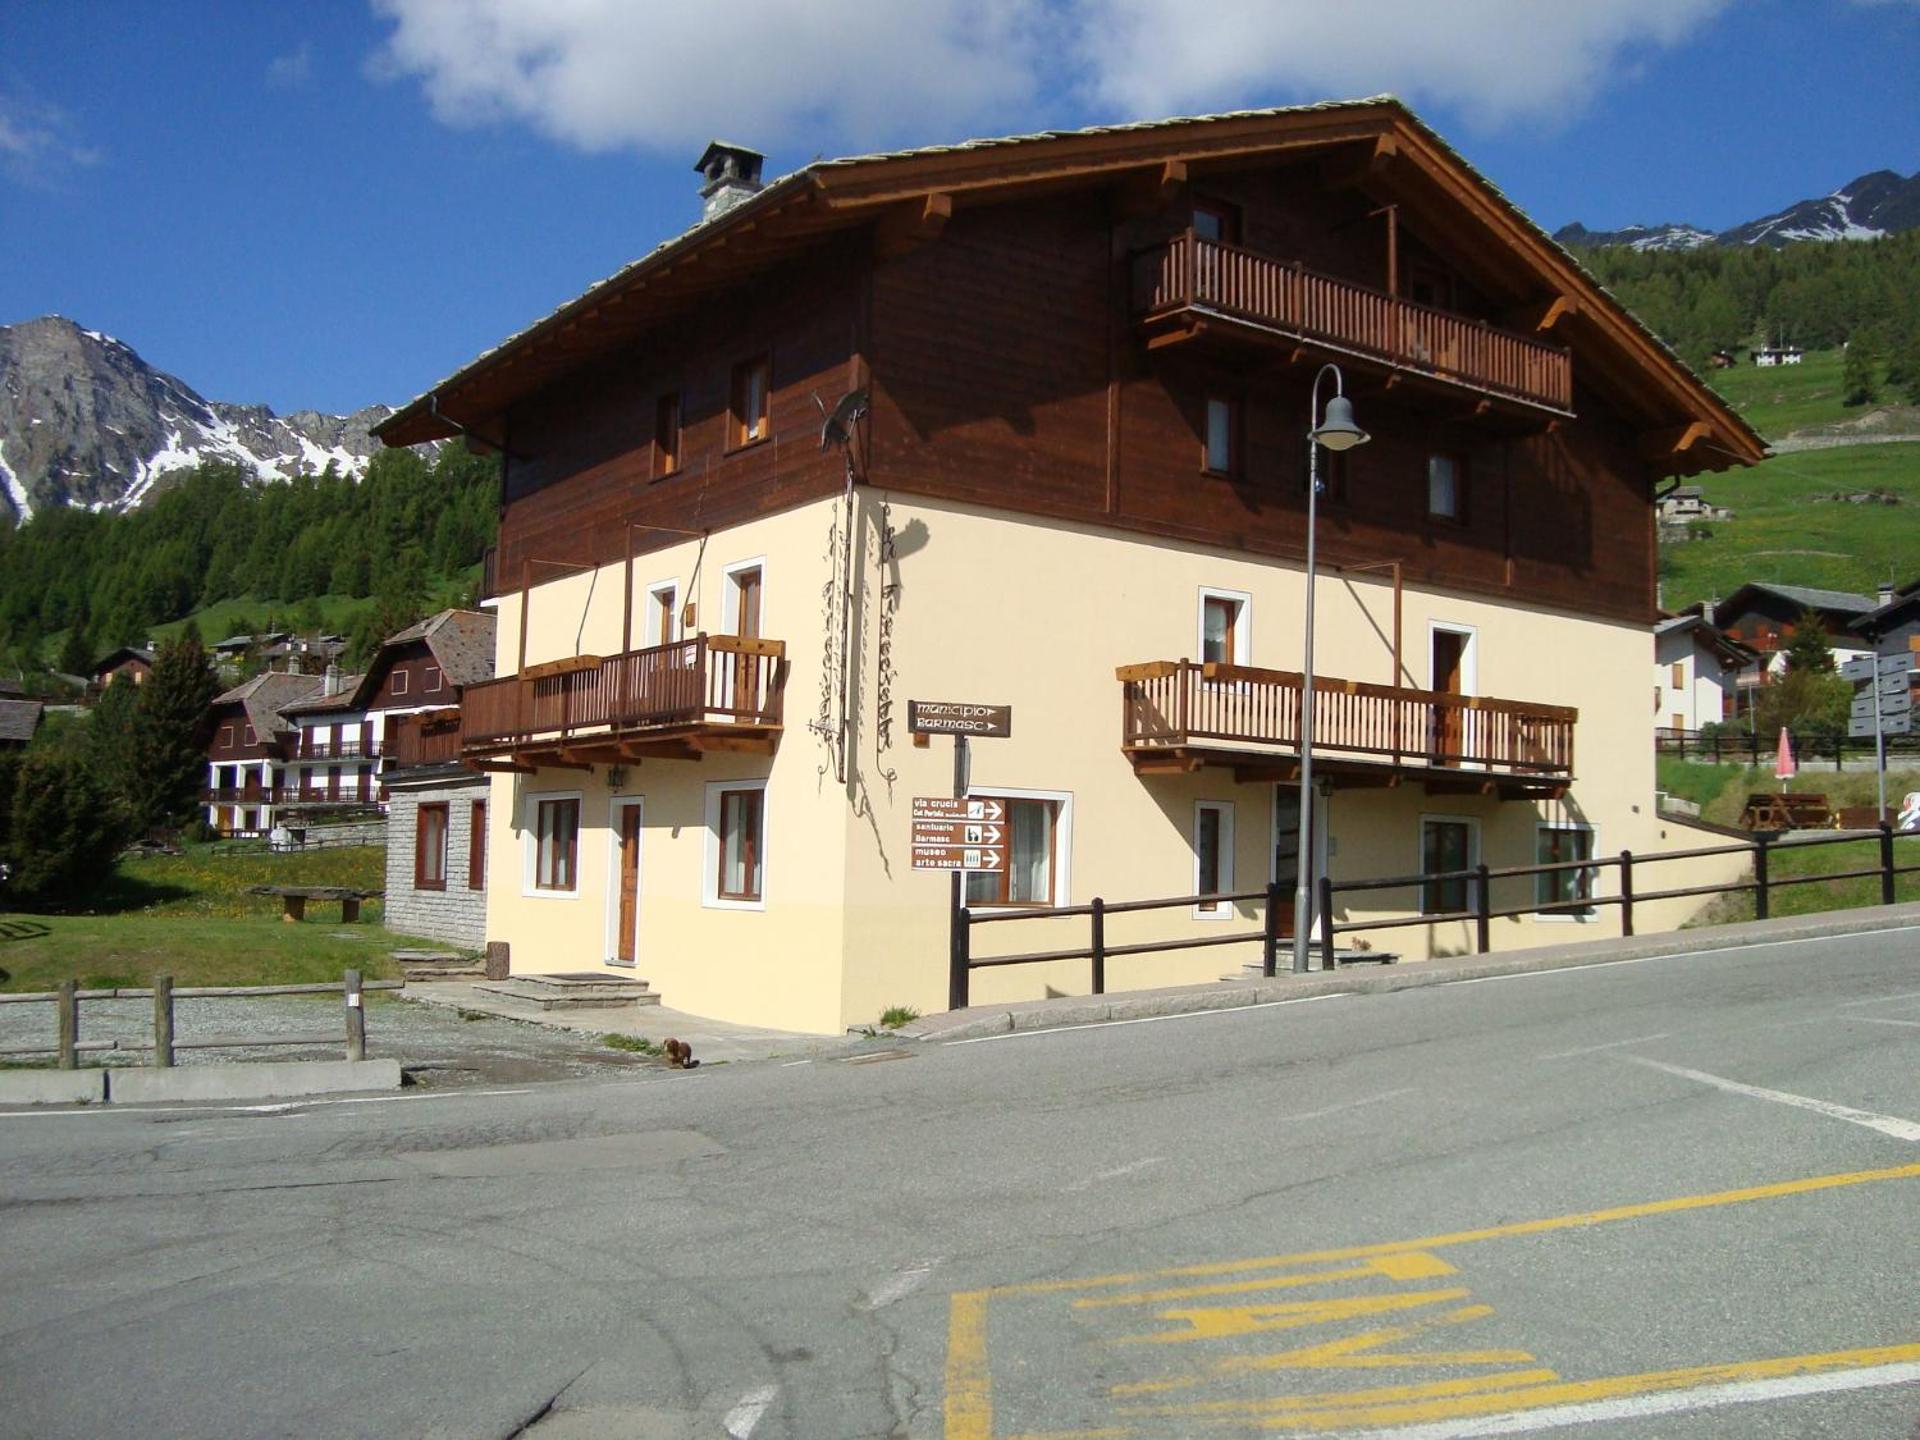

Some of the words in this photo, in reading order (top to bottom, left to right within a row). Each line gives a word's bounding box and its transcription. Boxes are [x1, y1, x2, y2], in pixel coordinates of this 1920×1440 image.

[914, 798, 928, 808] via
[931, 799, 959, 808] crucis
[916, 823, 954, 831] santuario
[915, 848, 947, 856] museo
